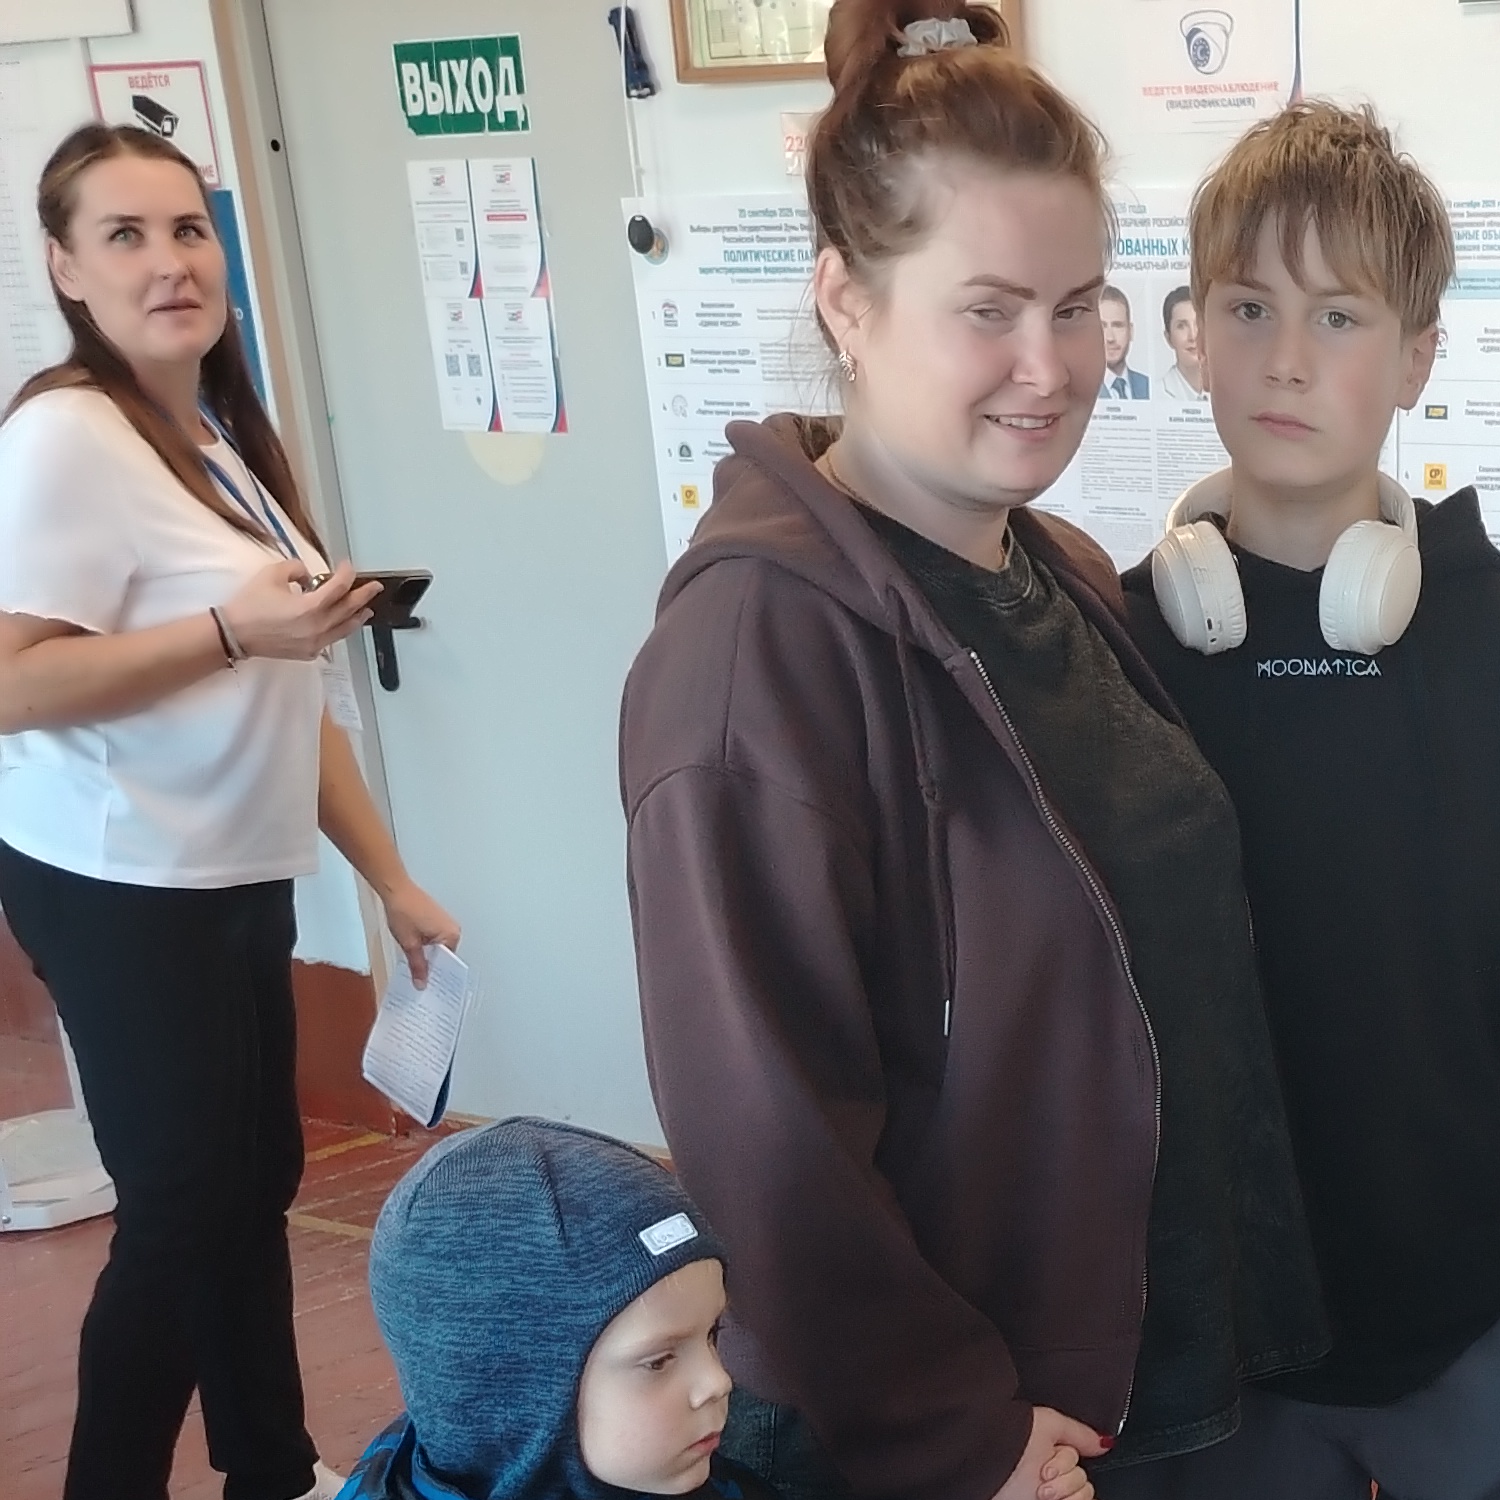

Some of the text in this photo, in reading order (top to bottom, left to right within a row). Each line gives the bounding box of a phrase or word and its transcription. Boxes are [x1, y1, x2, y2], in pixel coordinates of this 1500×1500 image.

[128, 73, 170, 90] ВЕДЁТСЯ
[401, 56, 525, 123] ВЫХОД
[723, 249, 795, 262] ПОЛИТИЧЕСКИЕ
[1116, 238, 1179, 256] ОВАННЫХ
[1256, 658, 1382, 677] MOONATICA
